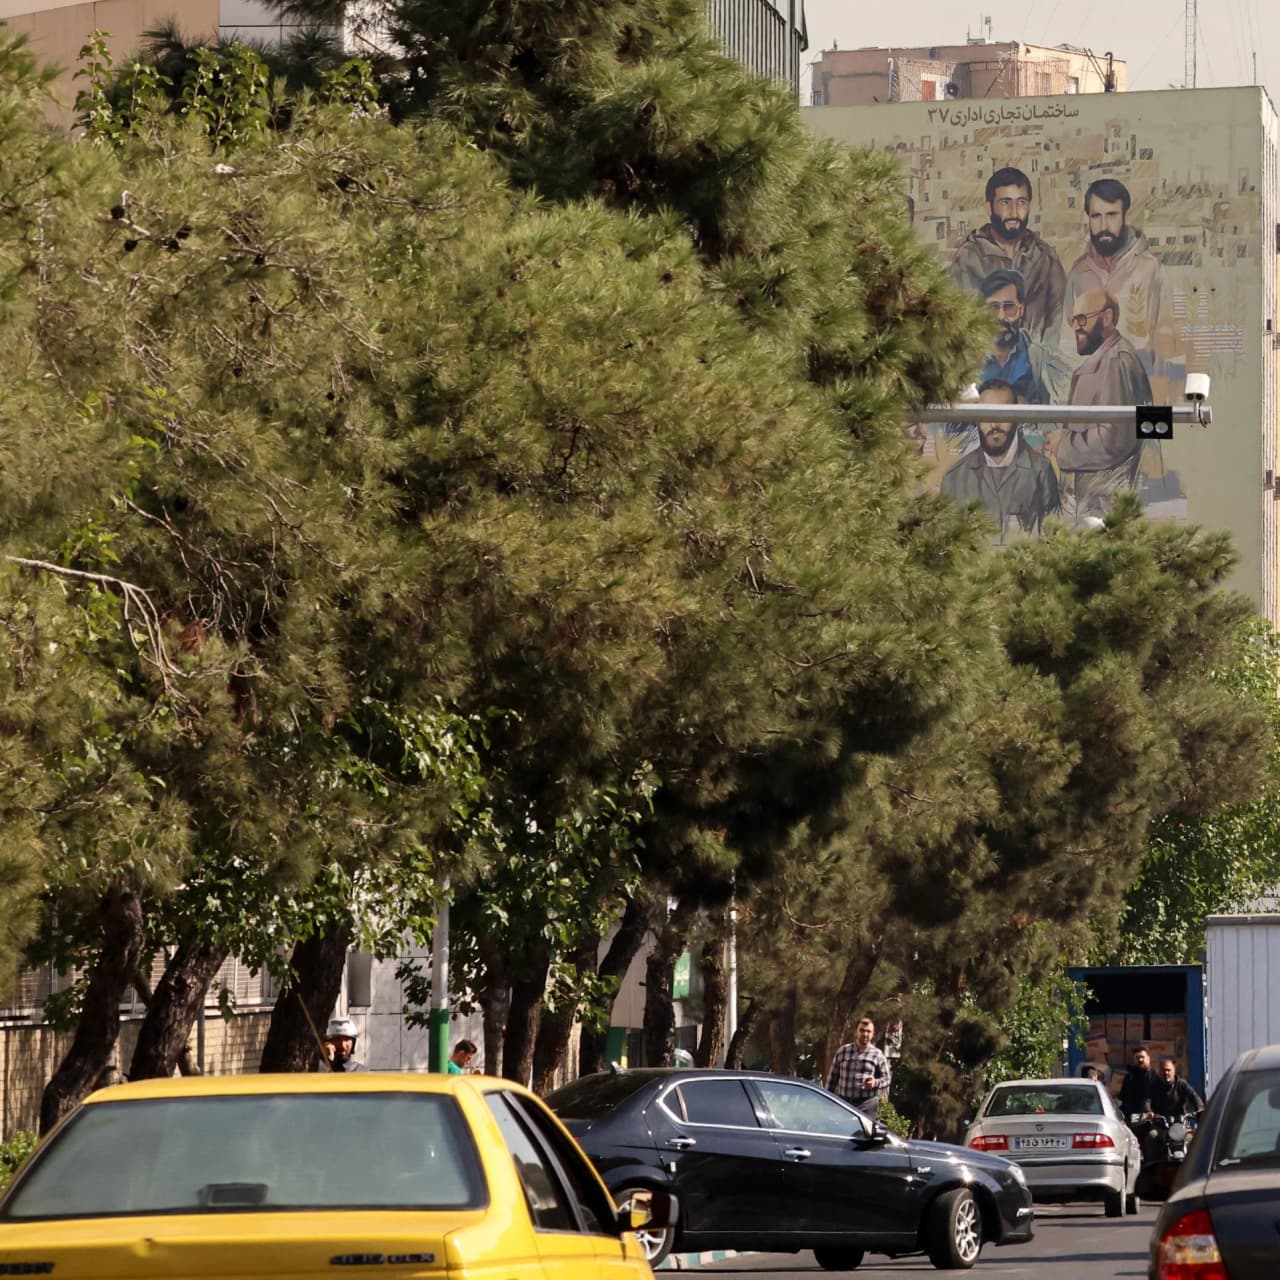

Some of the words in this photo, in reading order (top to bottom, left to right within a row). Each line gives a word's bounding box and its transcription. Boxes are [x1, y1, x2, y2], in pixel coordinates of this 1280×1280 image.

[927, 106, 950, 124] ۳۷
[949, 105, 983, 128] اداری
[983, 105, 1021, 125] تجاری
[1022, 103, 1080, 125] ساختمان
